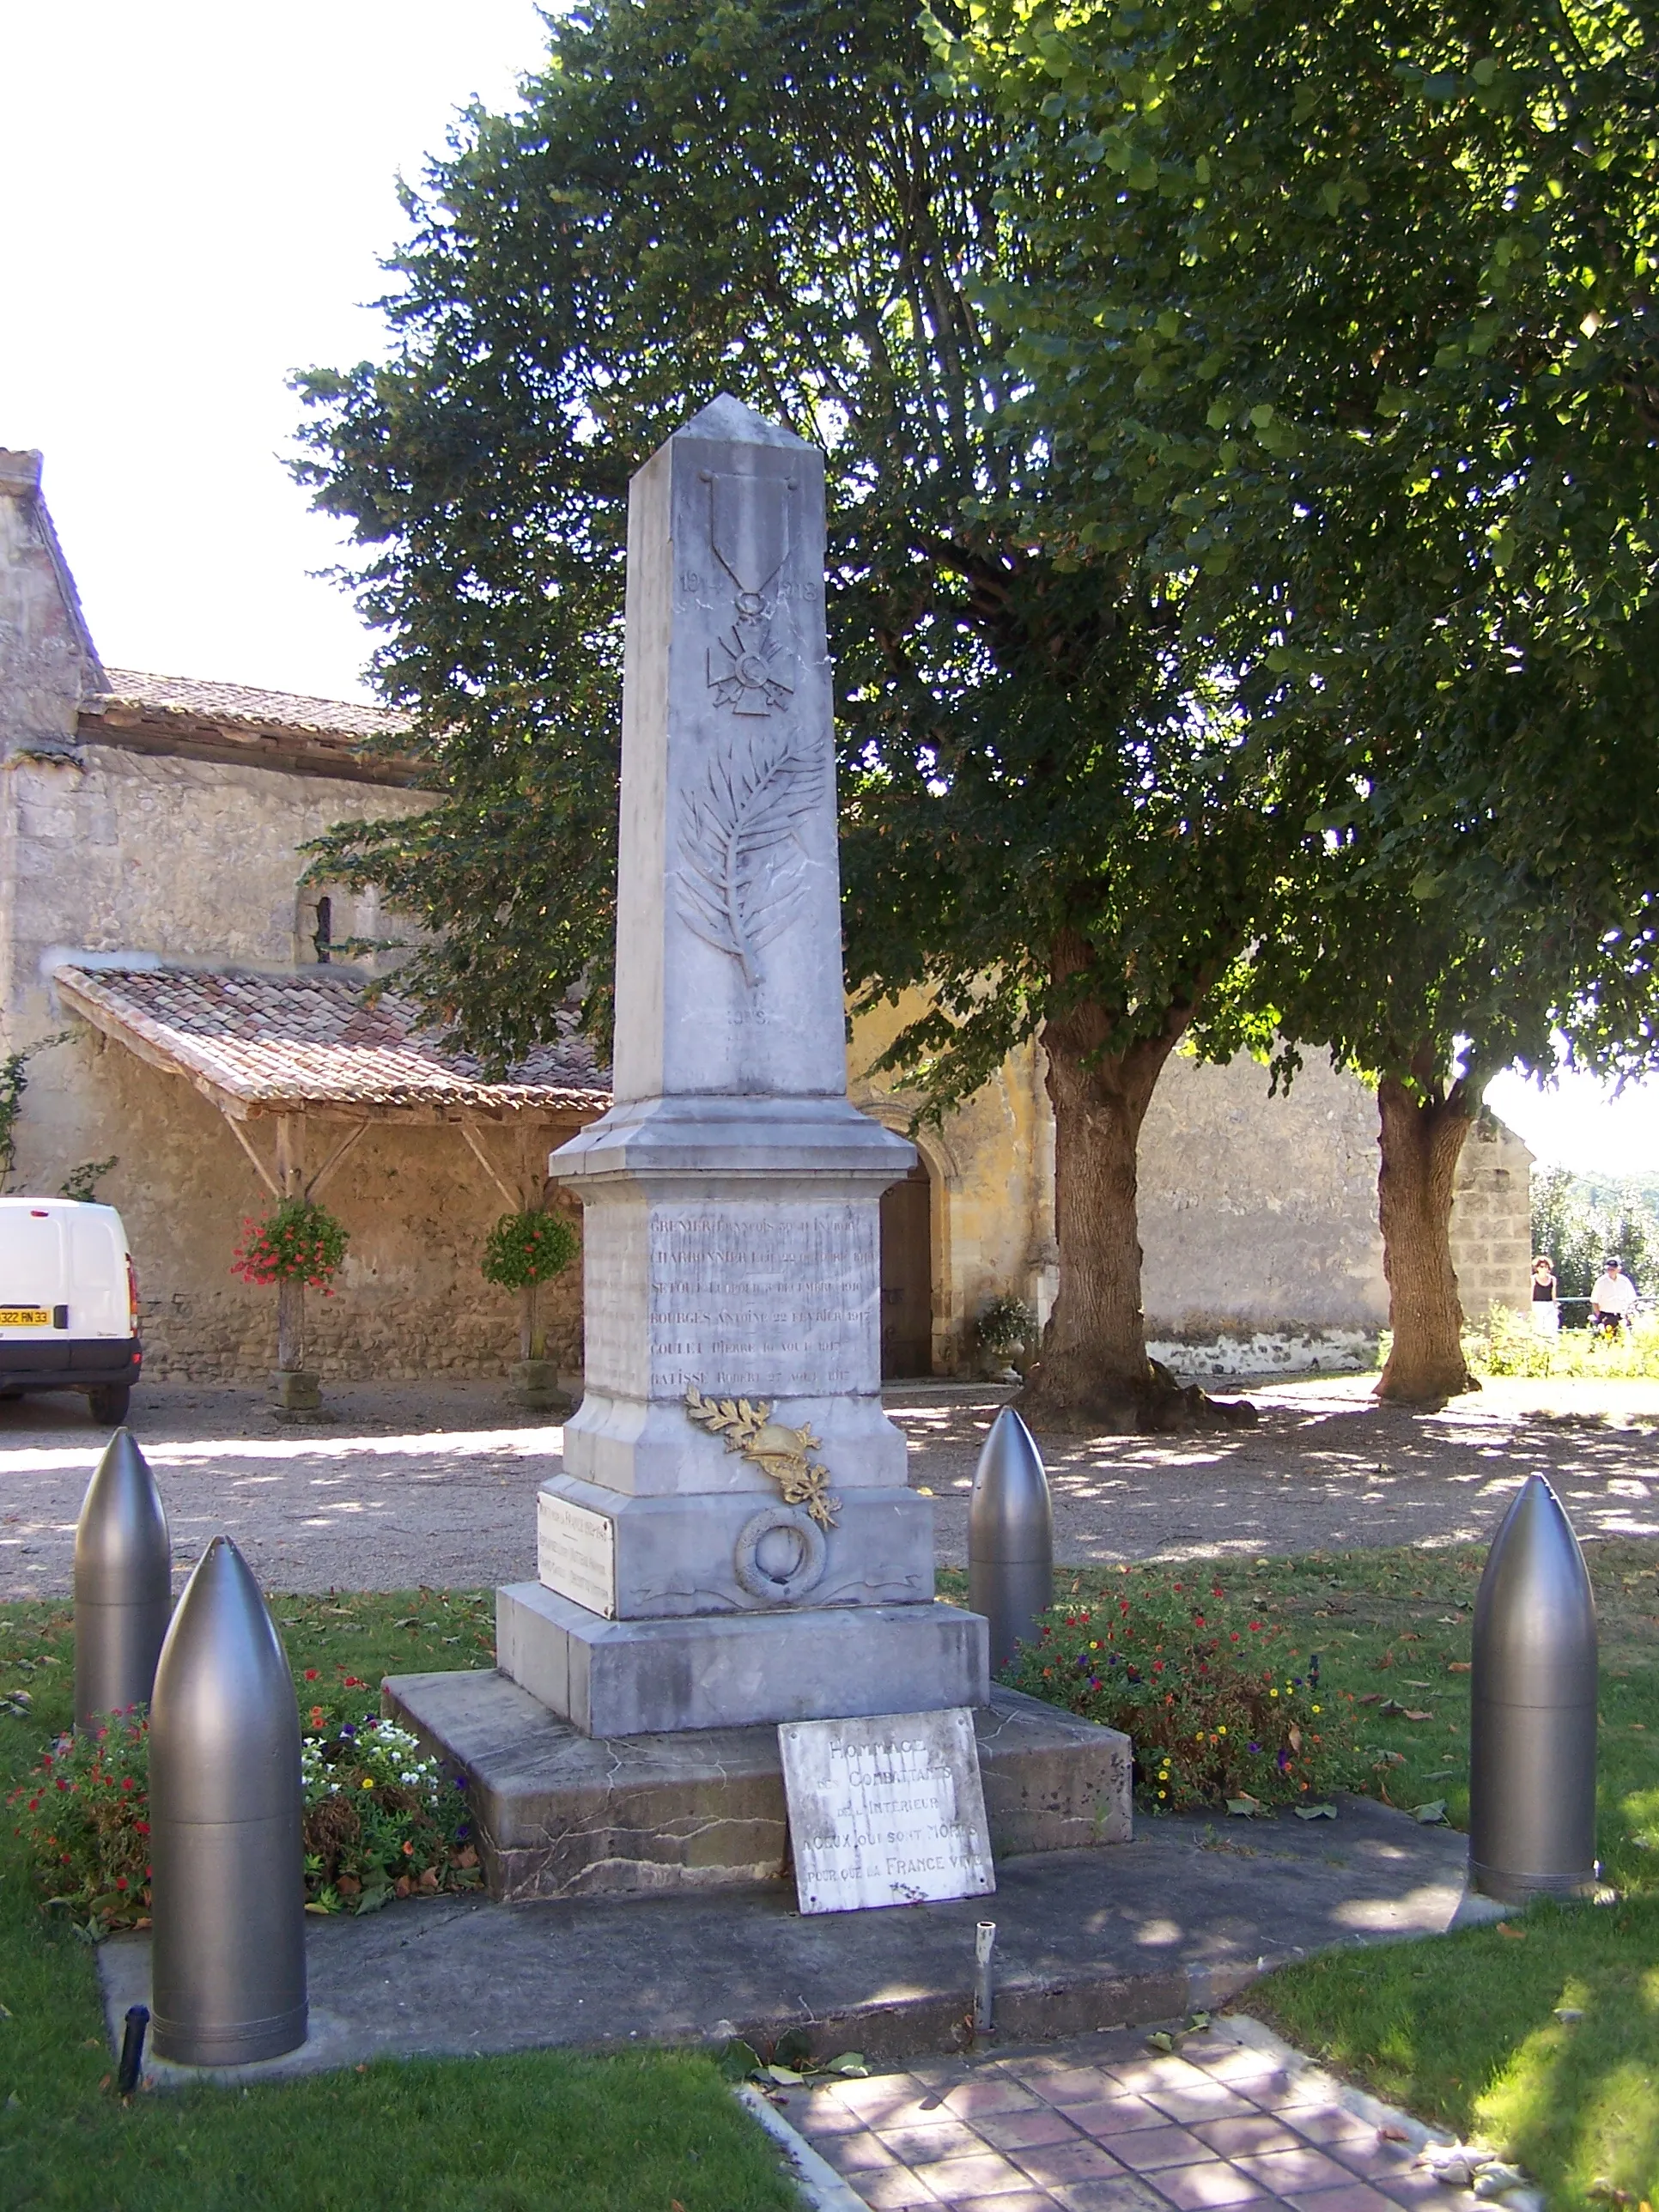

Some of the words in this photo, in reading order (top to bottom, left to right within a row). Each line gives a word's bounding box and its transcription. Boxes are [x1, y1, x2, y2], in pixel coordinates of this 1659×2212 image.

[651, 1220, 711, 1232] GRENIER
[651, 1251, 746, 1263] CHARBONNIER
[35, 1311, 47, 1322] 33
[651, 1312, 711, 1324] BOURGES
[773, 1312, 787, 1322] 22
[848, 1310, 872, 1322] 1917
[830, 1739, 927, 1759] HOMMAGE
[817, 1779, 839, 1790] DES
[849, 1765, 952, 1787] COMBATTANTS
[815, 1833, 852, 1850] CEUX
[858, 1833, 881, 1846] QUI
[888, 1830, 922, 1844] SONT
[928, 1823, 977, 1839] MORTS
[807, 1869, 838, 1882] POUR
[841, 1867, 862, 1880] QUE
[866, 1865, 880, 1878] LA
[885, 1856, 945, 1875] FRANCE
[949, 1853, 983, 1869] VIVE
